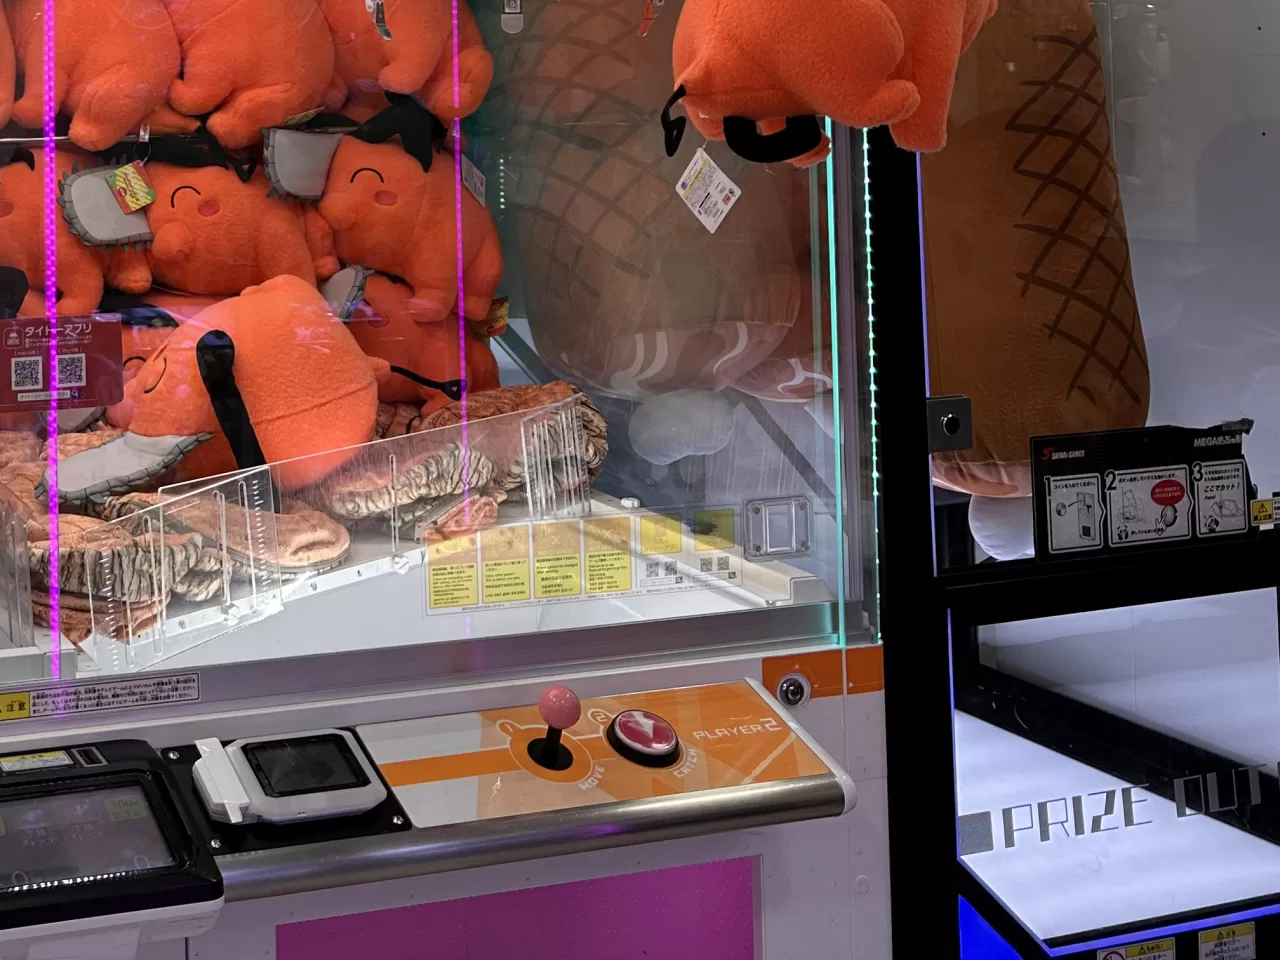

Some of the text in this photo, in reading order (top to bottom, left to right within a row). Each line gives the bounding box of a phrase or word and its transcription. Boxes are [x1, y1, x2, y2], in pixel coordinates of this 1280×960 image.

[1104, 470, 1117, 492] 2
[1192, 461, 1203, 482] 3
[1044, 476, 1052, 497] 1
[692, 717, 782, 741] PLAYER 2
[673, 747, 697, 778] CATCH
[578, 764, 605, 791] MOVE
[1001, 783, 1153, 849] PRIZE
